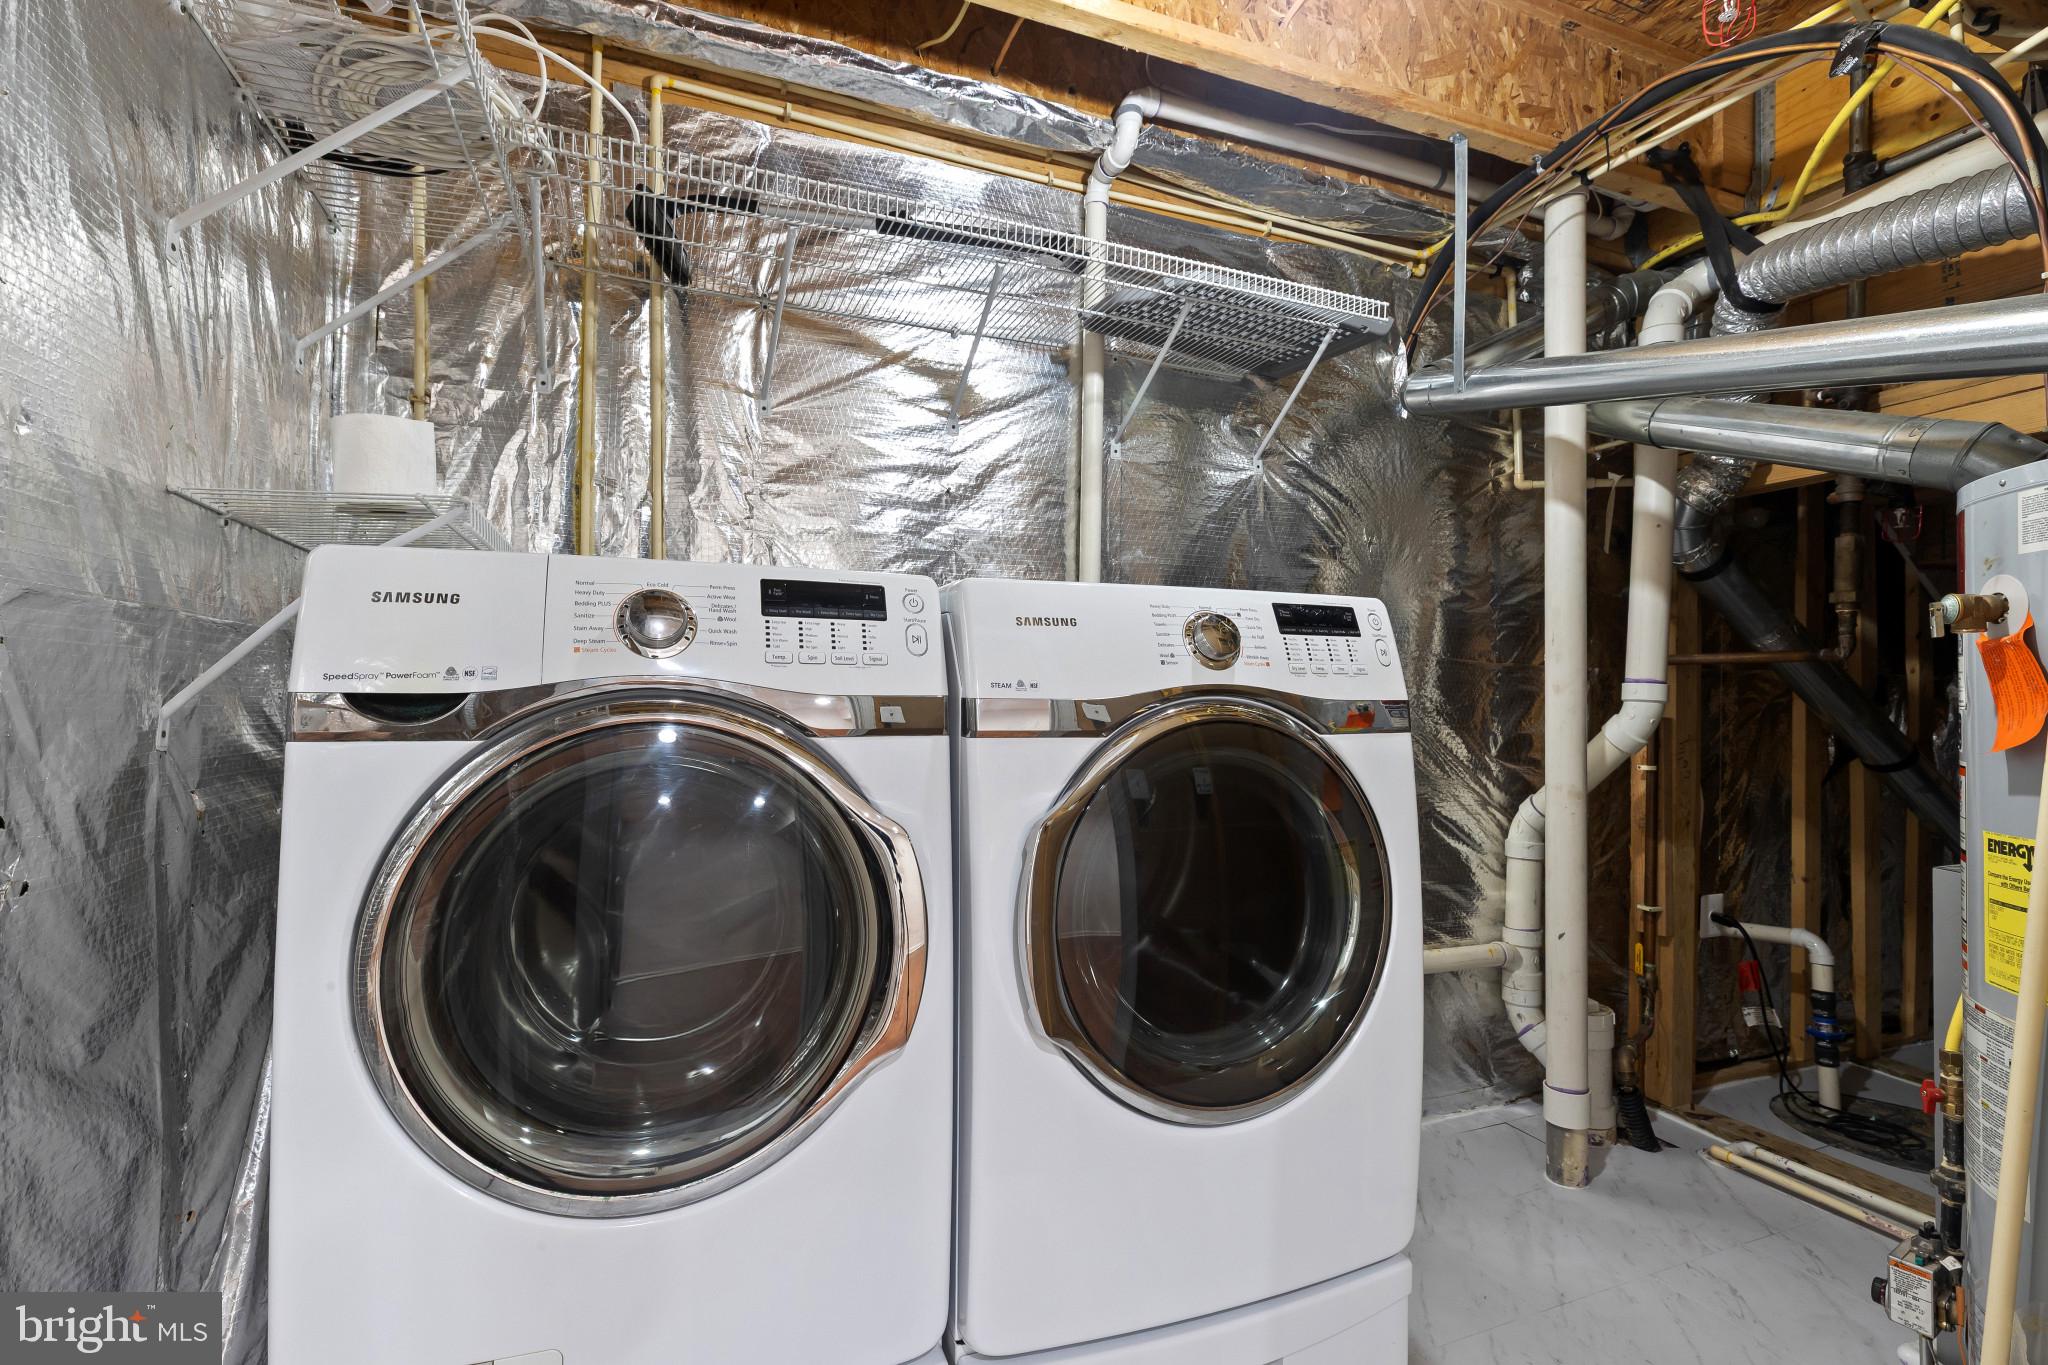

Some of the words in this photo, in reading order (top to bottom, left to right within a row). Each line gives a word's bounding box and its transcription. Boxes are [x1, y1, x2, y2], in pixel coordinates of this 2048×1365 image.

[371, 590, 461, 605] SAMSUNG
[1015, 616, 1078, 627] SAMSUNG
[464, 669, 475, 677] NSF
